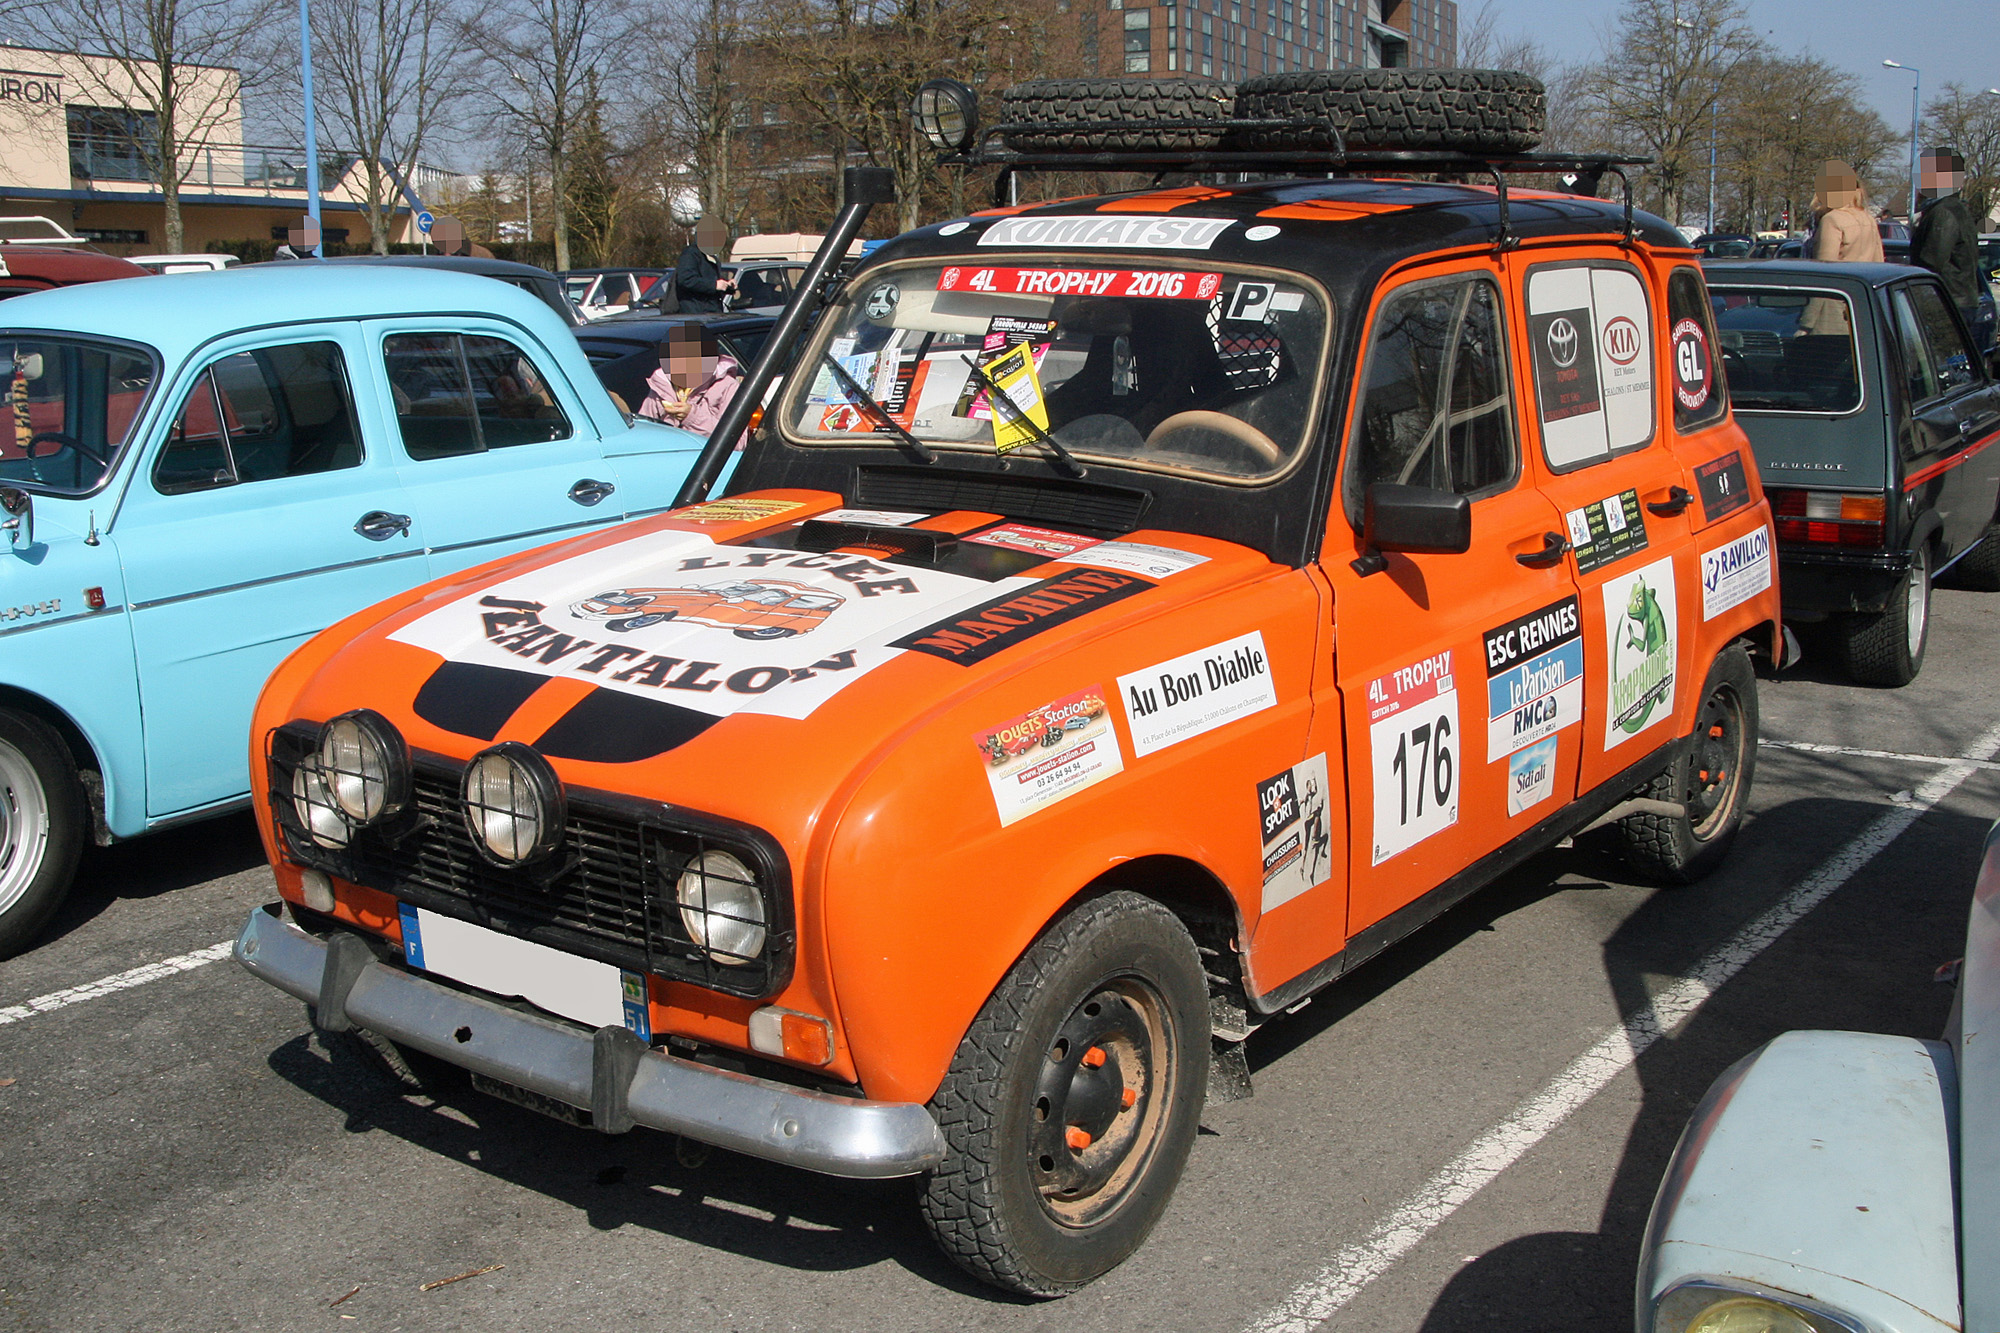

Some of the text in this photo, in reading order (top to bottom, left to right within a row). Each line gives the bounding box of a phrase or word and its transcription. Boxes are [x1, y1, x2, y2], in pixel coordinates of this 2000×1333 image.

[982, 218, 1223, 246] KOMATSU
[970, 269, 1187, 297] 4L TROPHY 2016
[1609, 327, 1636, 355] KIA
[1672, 321, 1703, 345] RAVALEMENT
[1556, 368, 1579, 383] TOYOTA
[1678, 341, 1703, 382] GL
[1678, 385, 1708, 408] RENOVATION
[1770, 461, 1843, 471] PEUGEOT
[1721, 529, 1769, 575] RAVILLON
[677, 552, 921, 598] LYCEE
[913, 571, 1134, 655] MACHINE
[1487, 603, 1578, 669] ESC RENNES
[1129, 645, 1265, 720] Au Bon Diable
[1369, 650, 1451, 703] 4L TROPHY
[995, 700, 1089, 747] JOUETS Station
[1371, 706, 1389, 720] EDITION
[1513, 699, 1543, 736] RMC
[1020, 743, 1094, 781] www.jouets-station.com
[1037, 761, 1081, 788] 03 26 64 94 94
[1393, 714, 1452, 827] 176
[1261, 774, 1290, 811] LOOK
[1516, 769, 1534, 794] Sidi
[1265, 798, 1293, 834] SPORT
[1266, 836, 1298, 868] CHAUSSURES
[409, 942, 417, 956] F
[624, 1008, 646, 1035] 51
